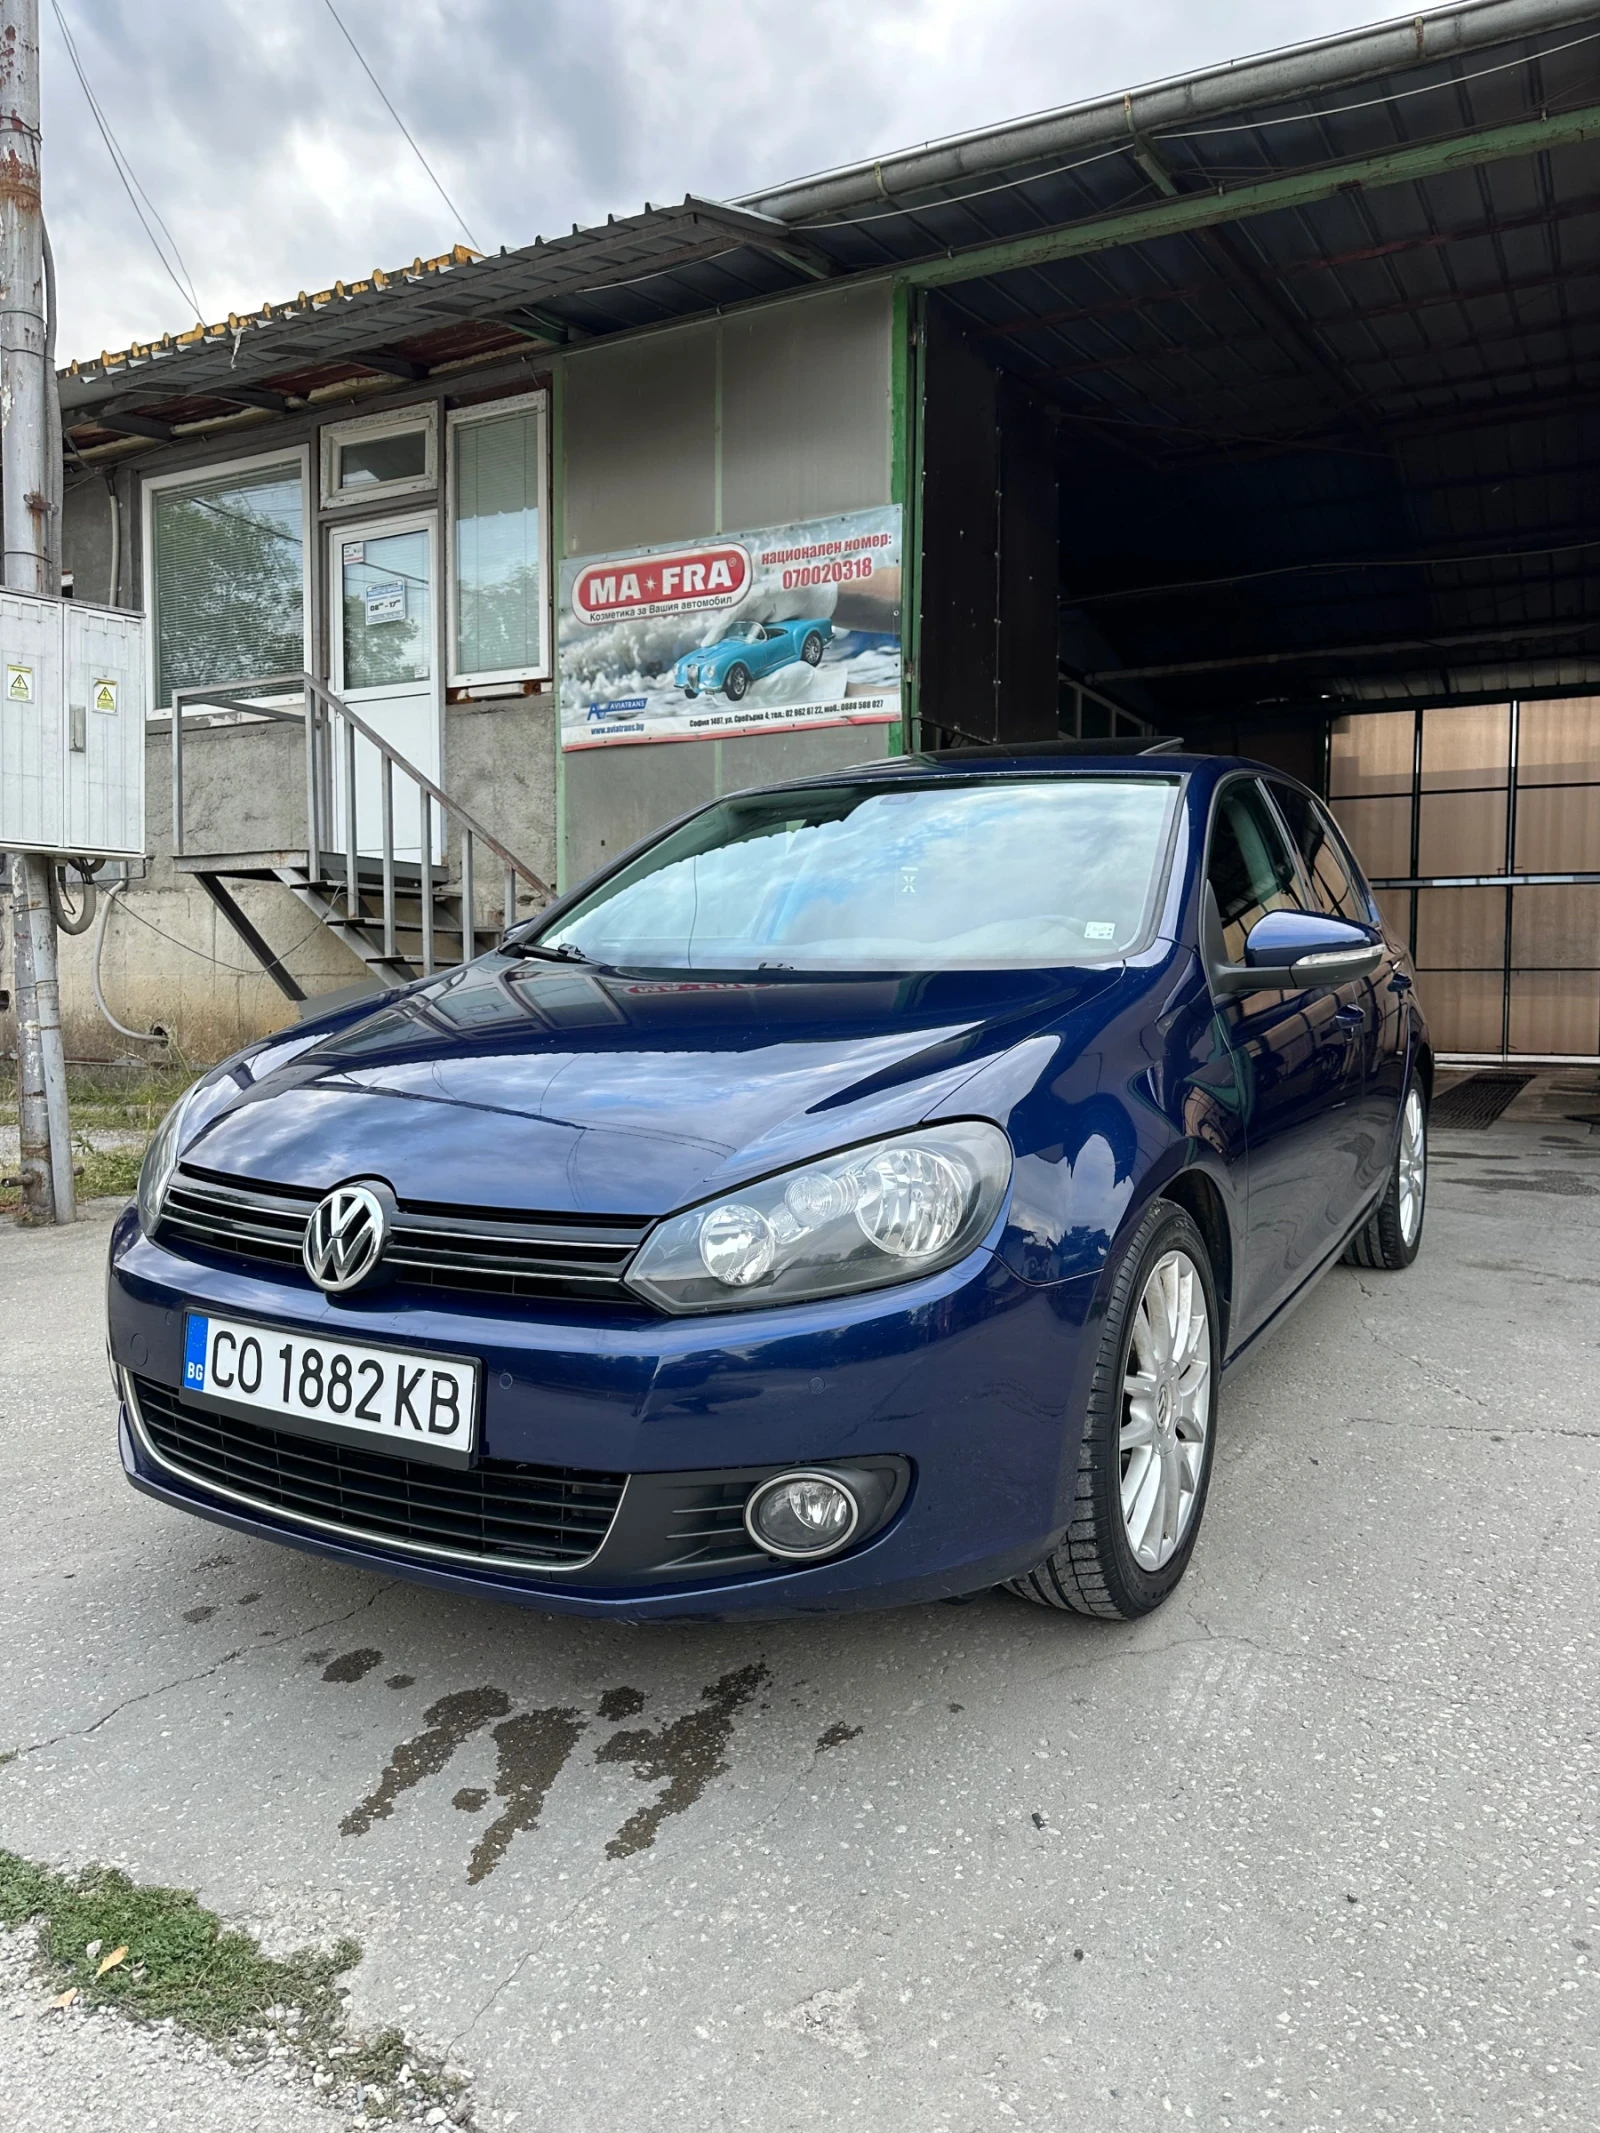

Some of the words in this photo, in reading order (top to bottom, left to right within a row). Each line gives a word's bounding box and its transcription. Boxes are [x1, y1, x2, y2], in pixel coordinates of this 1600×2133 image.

[761, 541, 842, 565] национален
[844, 533, 892, 552] номер:
[589, 573, 642, 606] MA
[661, 559, 733, 595] FRA
[782, 557, 872, 590] 070020318
[589, 608, 635, 622] Козметика
[637, 607, 647, 616] за
[649, 603, 679, 614] Вашия
[681, 595, 733, 610] автомобил
[609, 699, 645, 711] AVIATRANS
[689, 718, 710, 727] София
[725, 717, 733, 725] ул.
[785, 709, 793, 718] 02
[871, 699, 884, 708] 027
[591, 723, 645, 735] www.aviatrans.bg
[187, 1361, 204, 1382] BG
[211, 1330, 263, 1395] CO
[279, 1343, 385, 1424] 1882
[394, 1364, 460, 1436] KB
